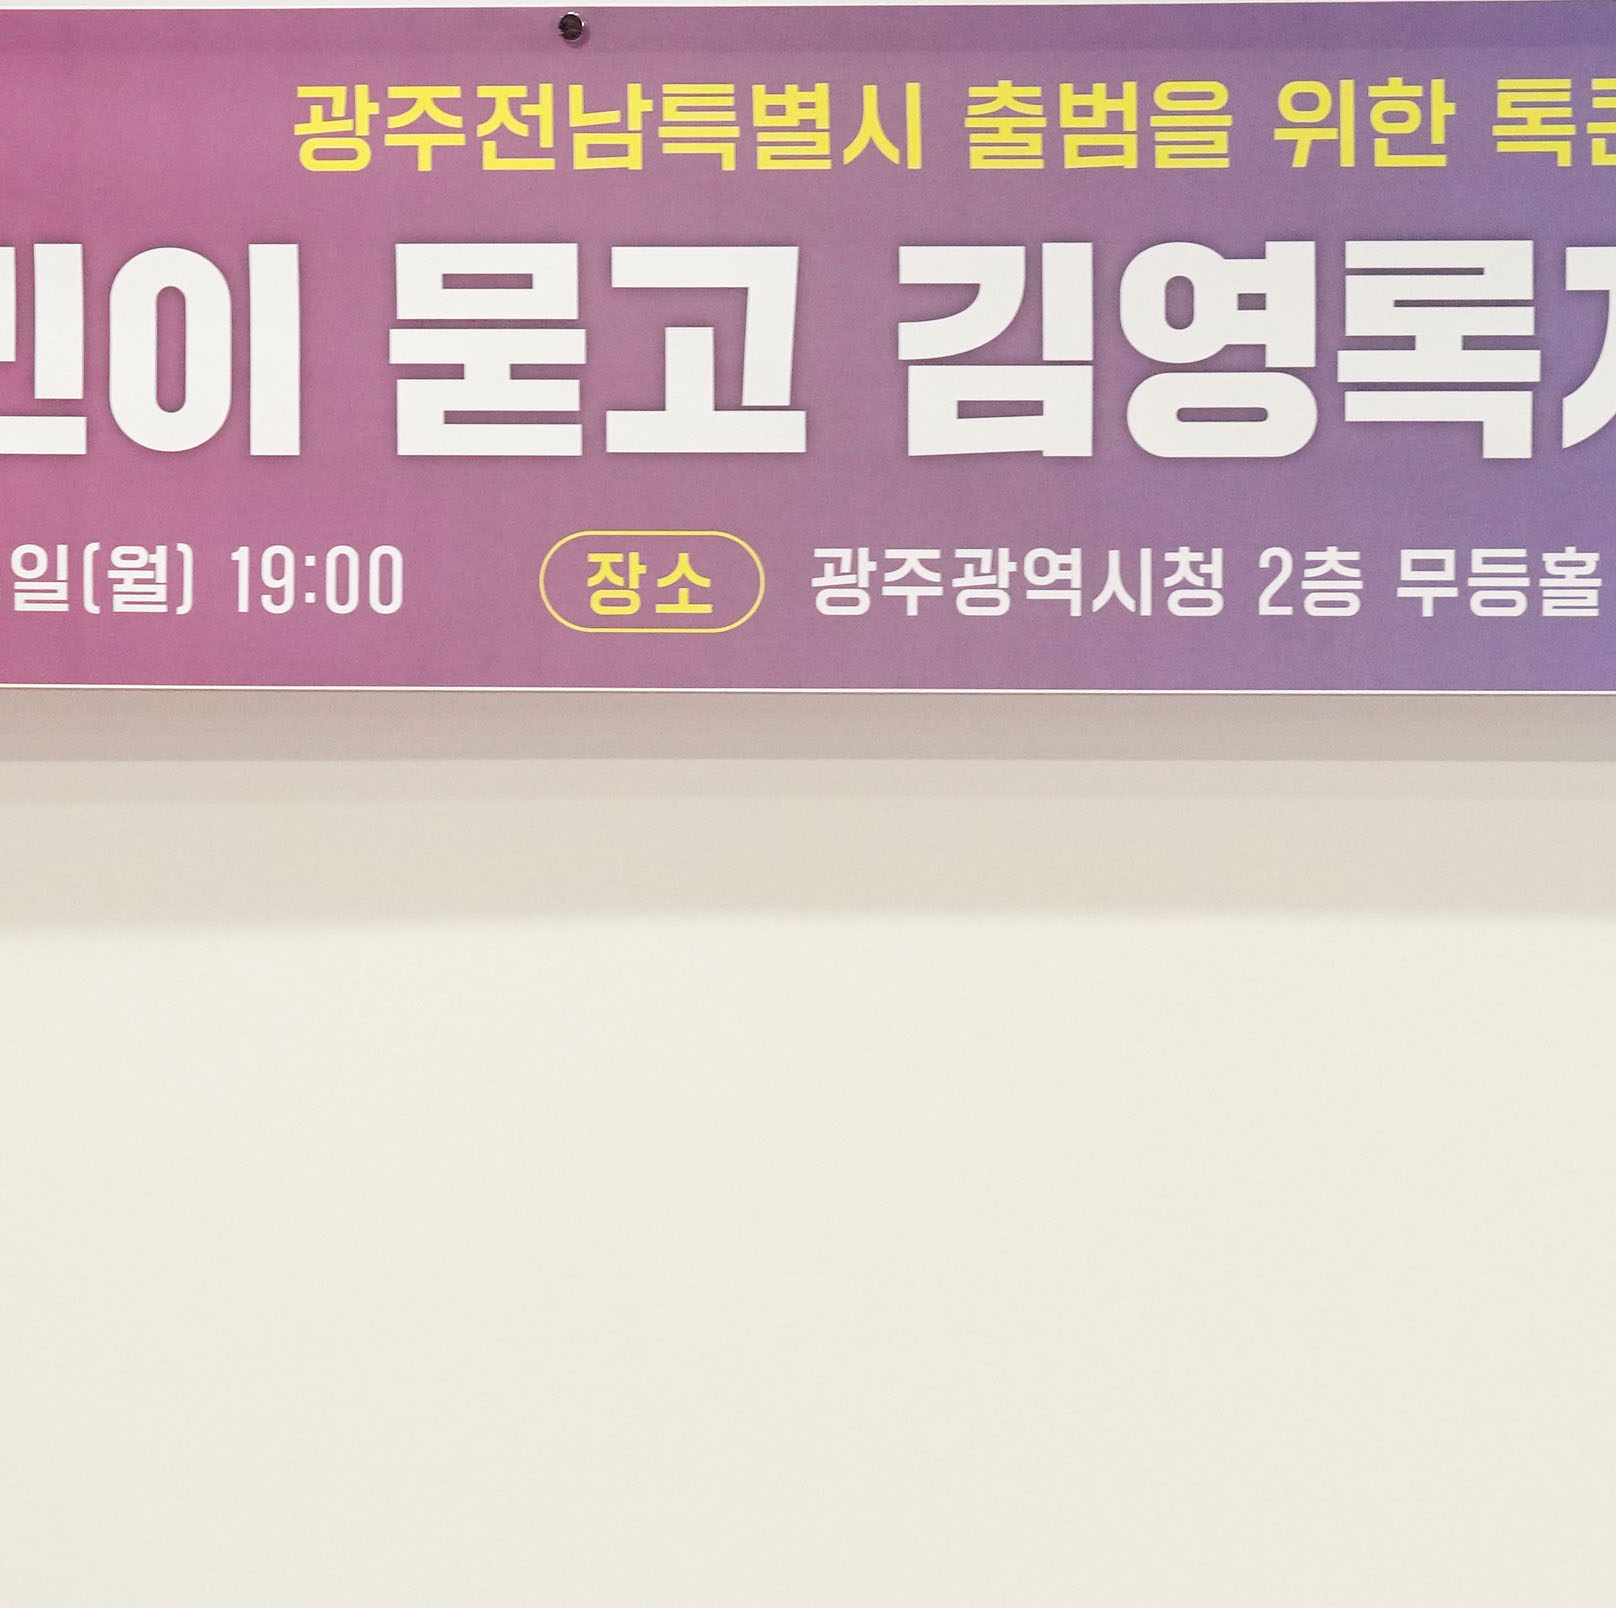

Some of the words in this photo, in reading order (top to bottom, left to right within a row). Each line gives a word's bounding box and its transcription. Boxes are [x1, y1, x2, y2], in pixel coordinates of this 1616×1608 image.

[293, 81, 923, 173] 광주전남특별시
[964, 79, 1234, 170] 출범을
[1273, 75, 1457, 169] 위한
[388, 241, 807, 458] 묻고
[230, 543, 404, 616] 19:00
[586, 550, 713, 617] 장소
[810, 545, 1225, 618] 광주광역시청
[1257, 545, 1365, 618] 2층
[1395, 545, 1603, 618] 무등홀
